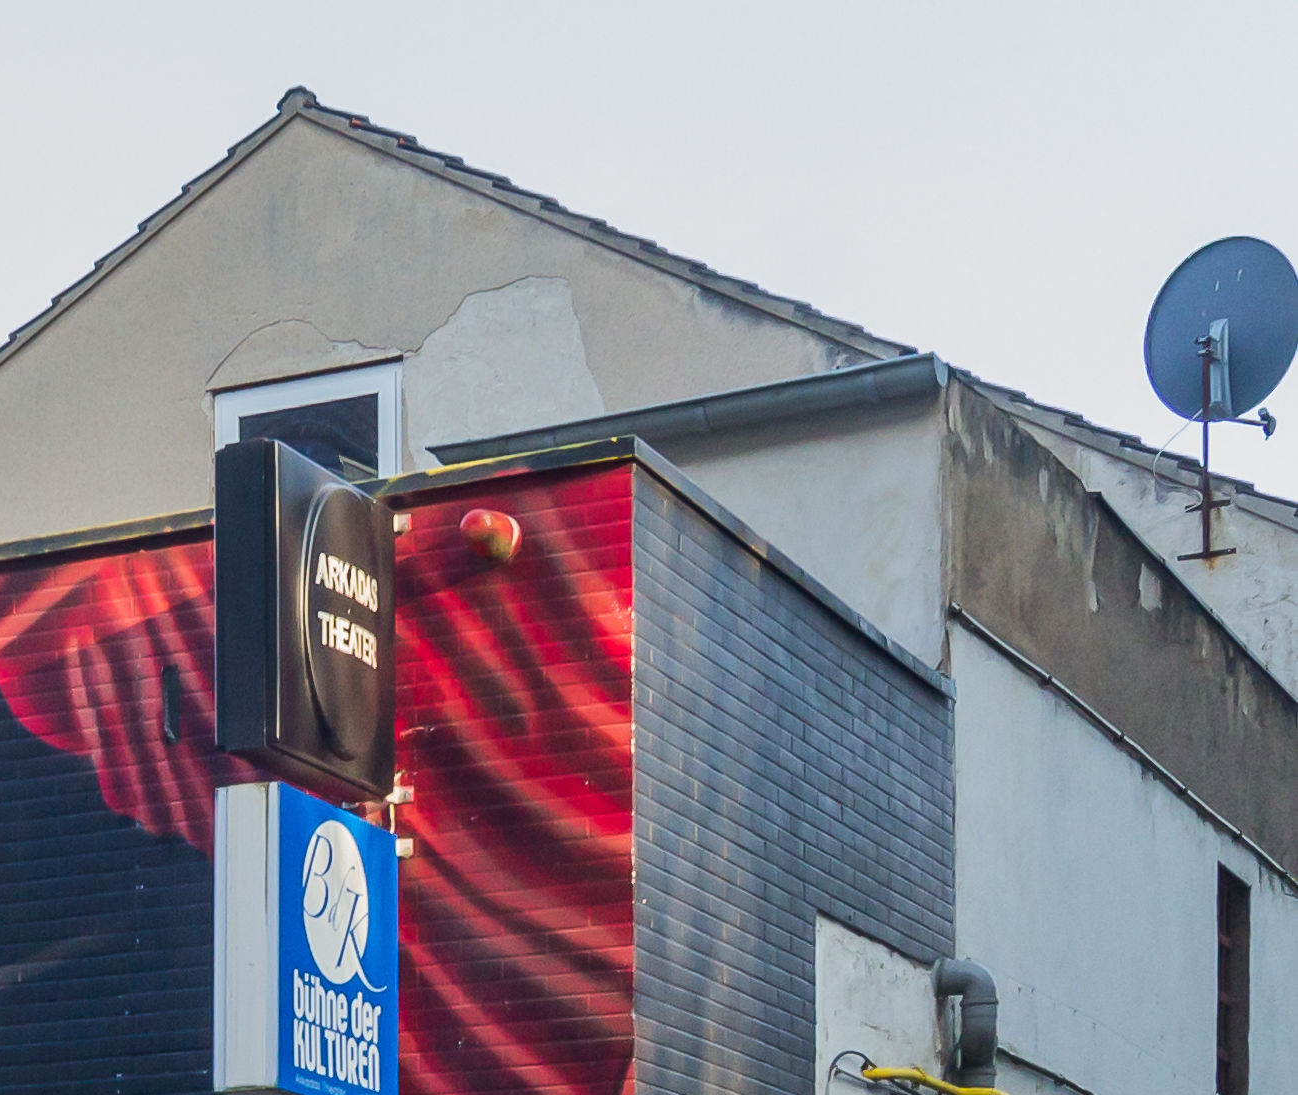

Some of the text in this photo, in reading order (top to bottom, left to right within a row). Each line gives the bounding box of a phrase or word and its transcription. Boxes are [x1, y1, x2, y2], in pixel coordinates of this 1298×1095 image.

[317, 610, 378, 670] THEATER
[293, 968, 382, 1045] bühne der
[293, 1018, 381, 1093] KULTUREN
